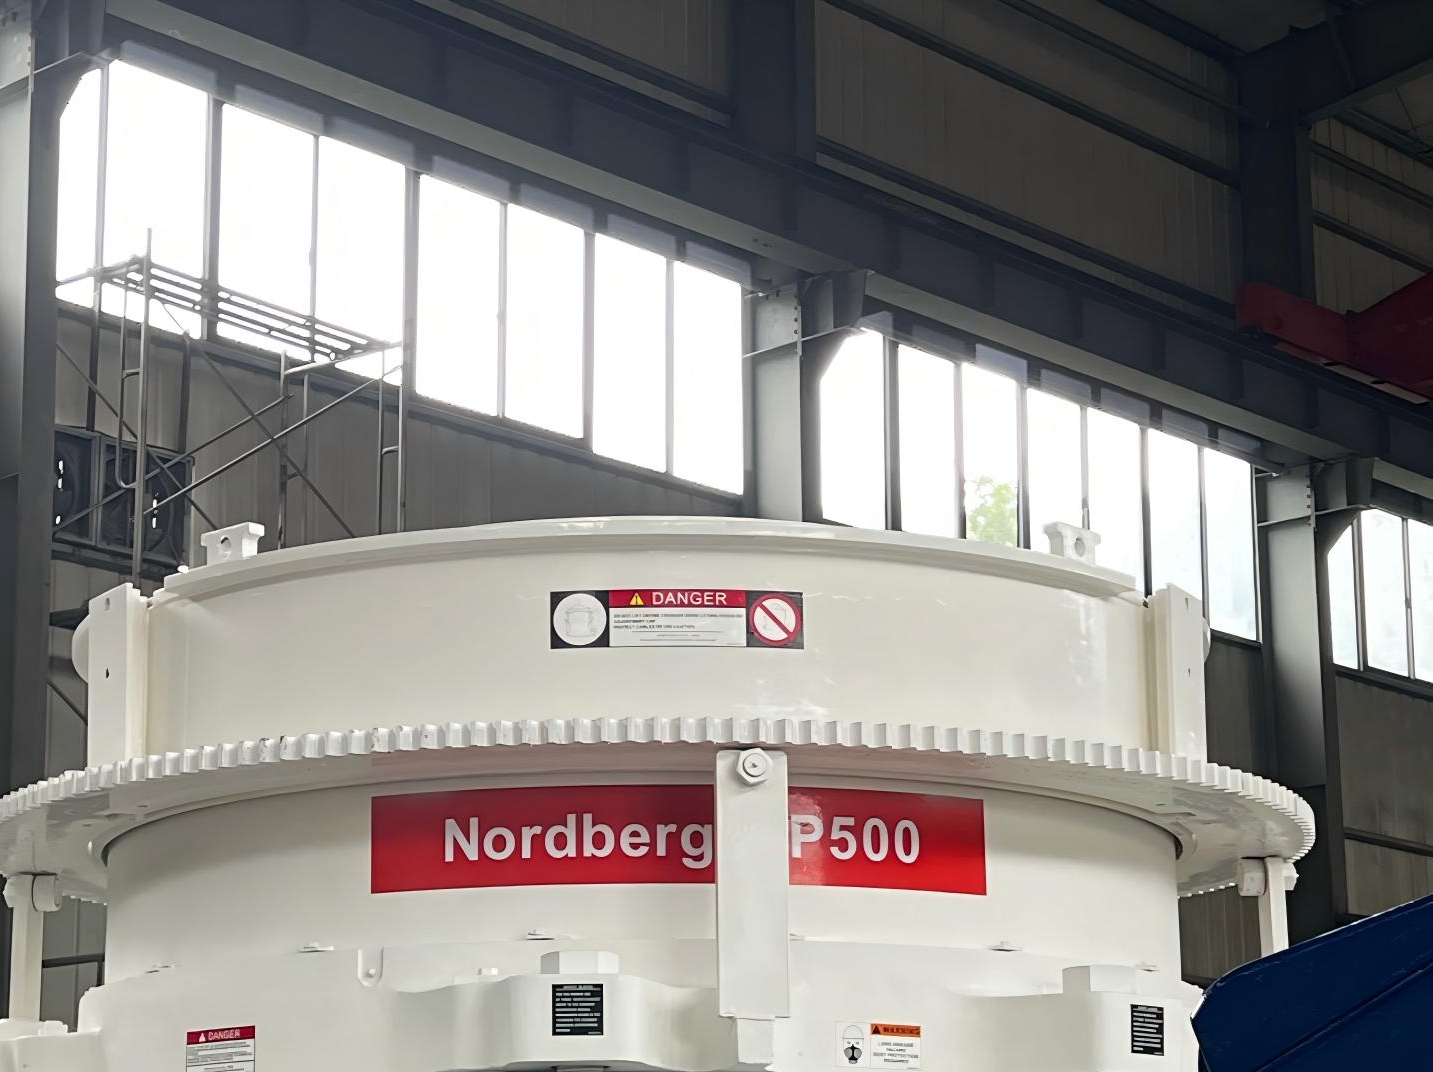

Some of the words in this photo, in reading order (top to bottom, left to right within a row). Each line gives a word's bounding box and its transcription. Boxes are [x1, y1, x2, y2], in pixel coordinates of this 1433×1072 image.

[652, 591, 727, 605] DANGER
[444, 812, 713, 869] Nordberg
[790, 813, 920, 864] P500
[208, 1029, 241, 1041] DANGER
